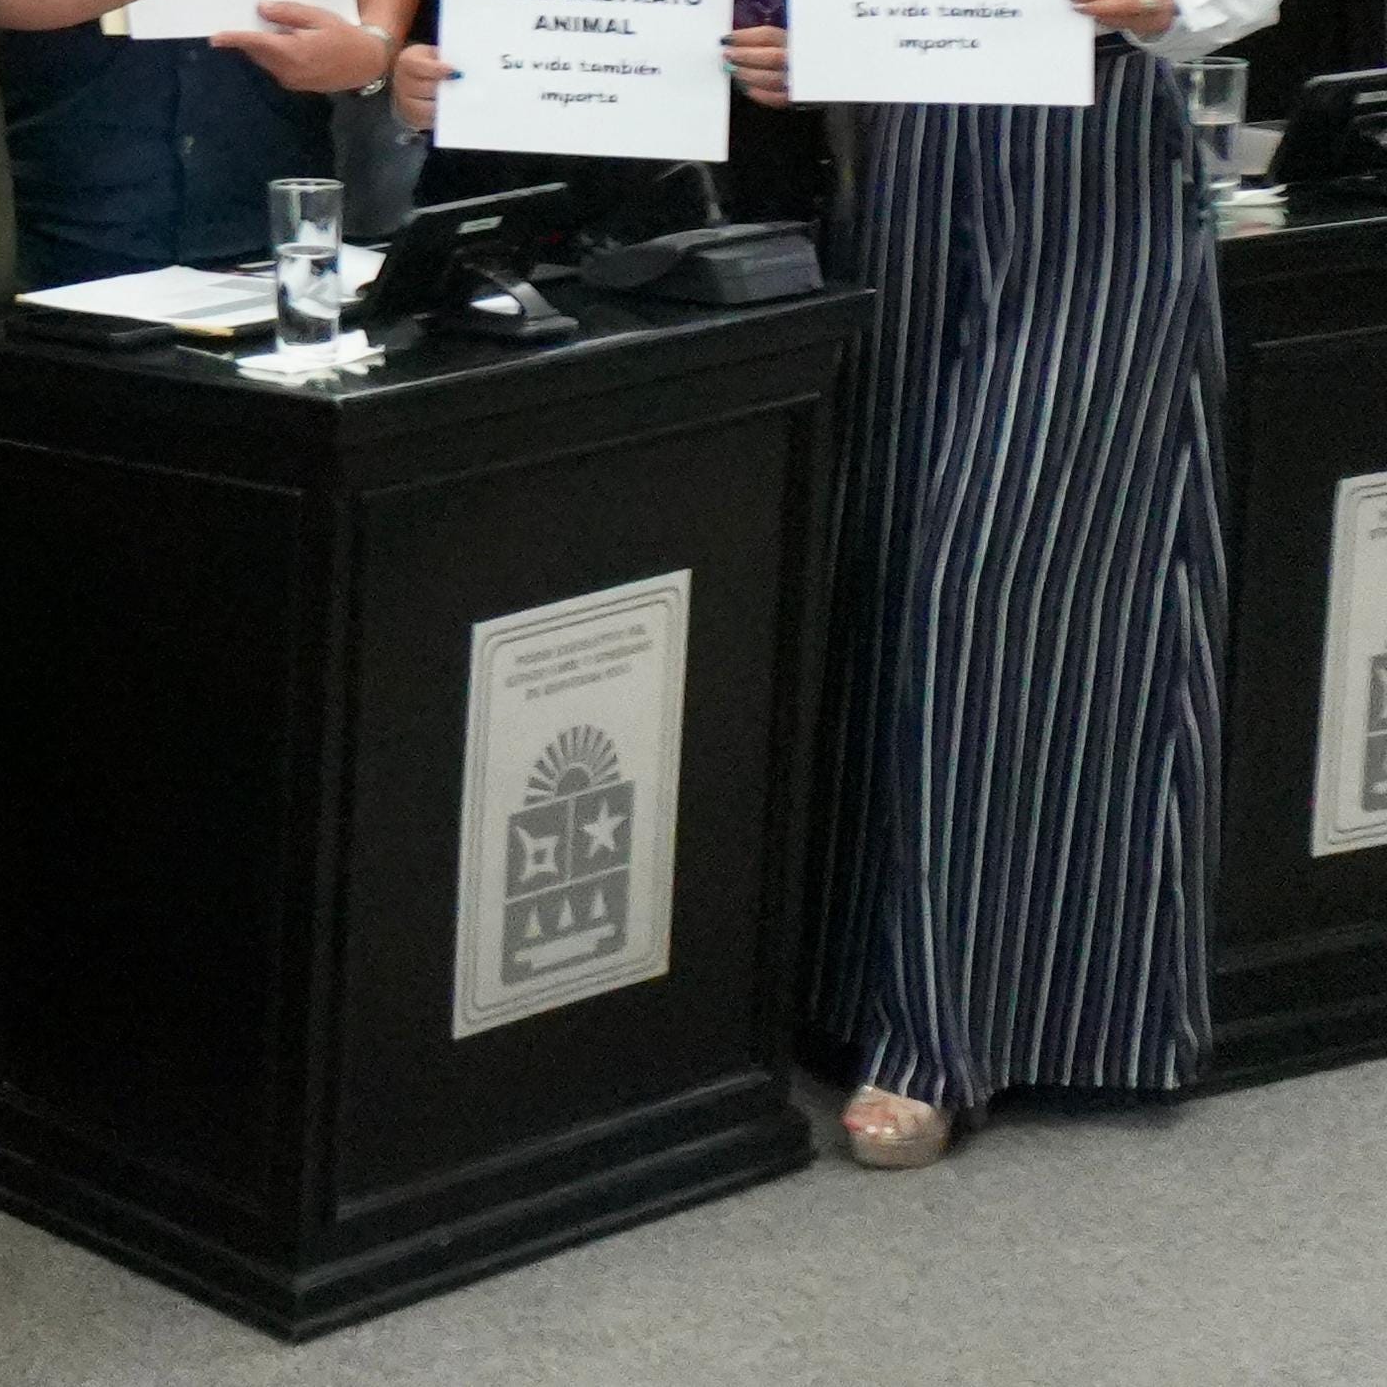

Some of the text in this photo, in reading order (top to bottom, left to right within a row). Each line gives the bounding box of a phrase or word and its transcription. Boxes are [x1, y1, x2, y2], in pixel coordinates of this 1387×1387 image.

[534, 14, 637, 35] ANIMAL
[501, 54, 661, 75] Su vida también
[541, 92, 618, 107] importa
